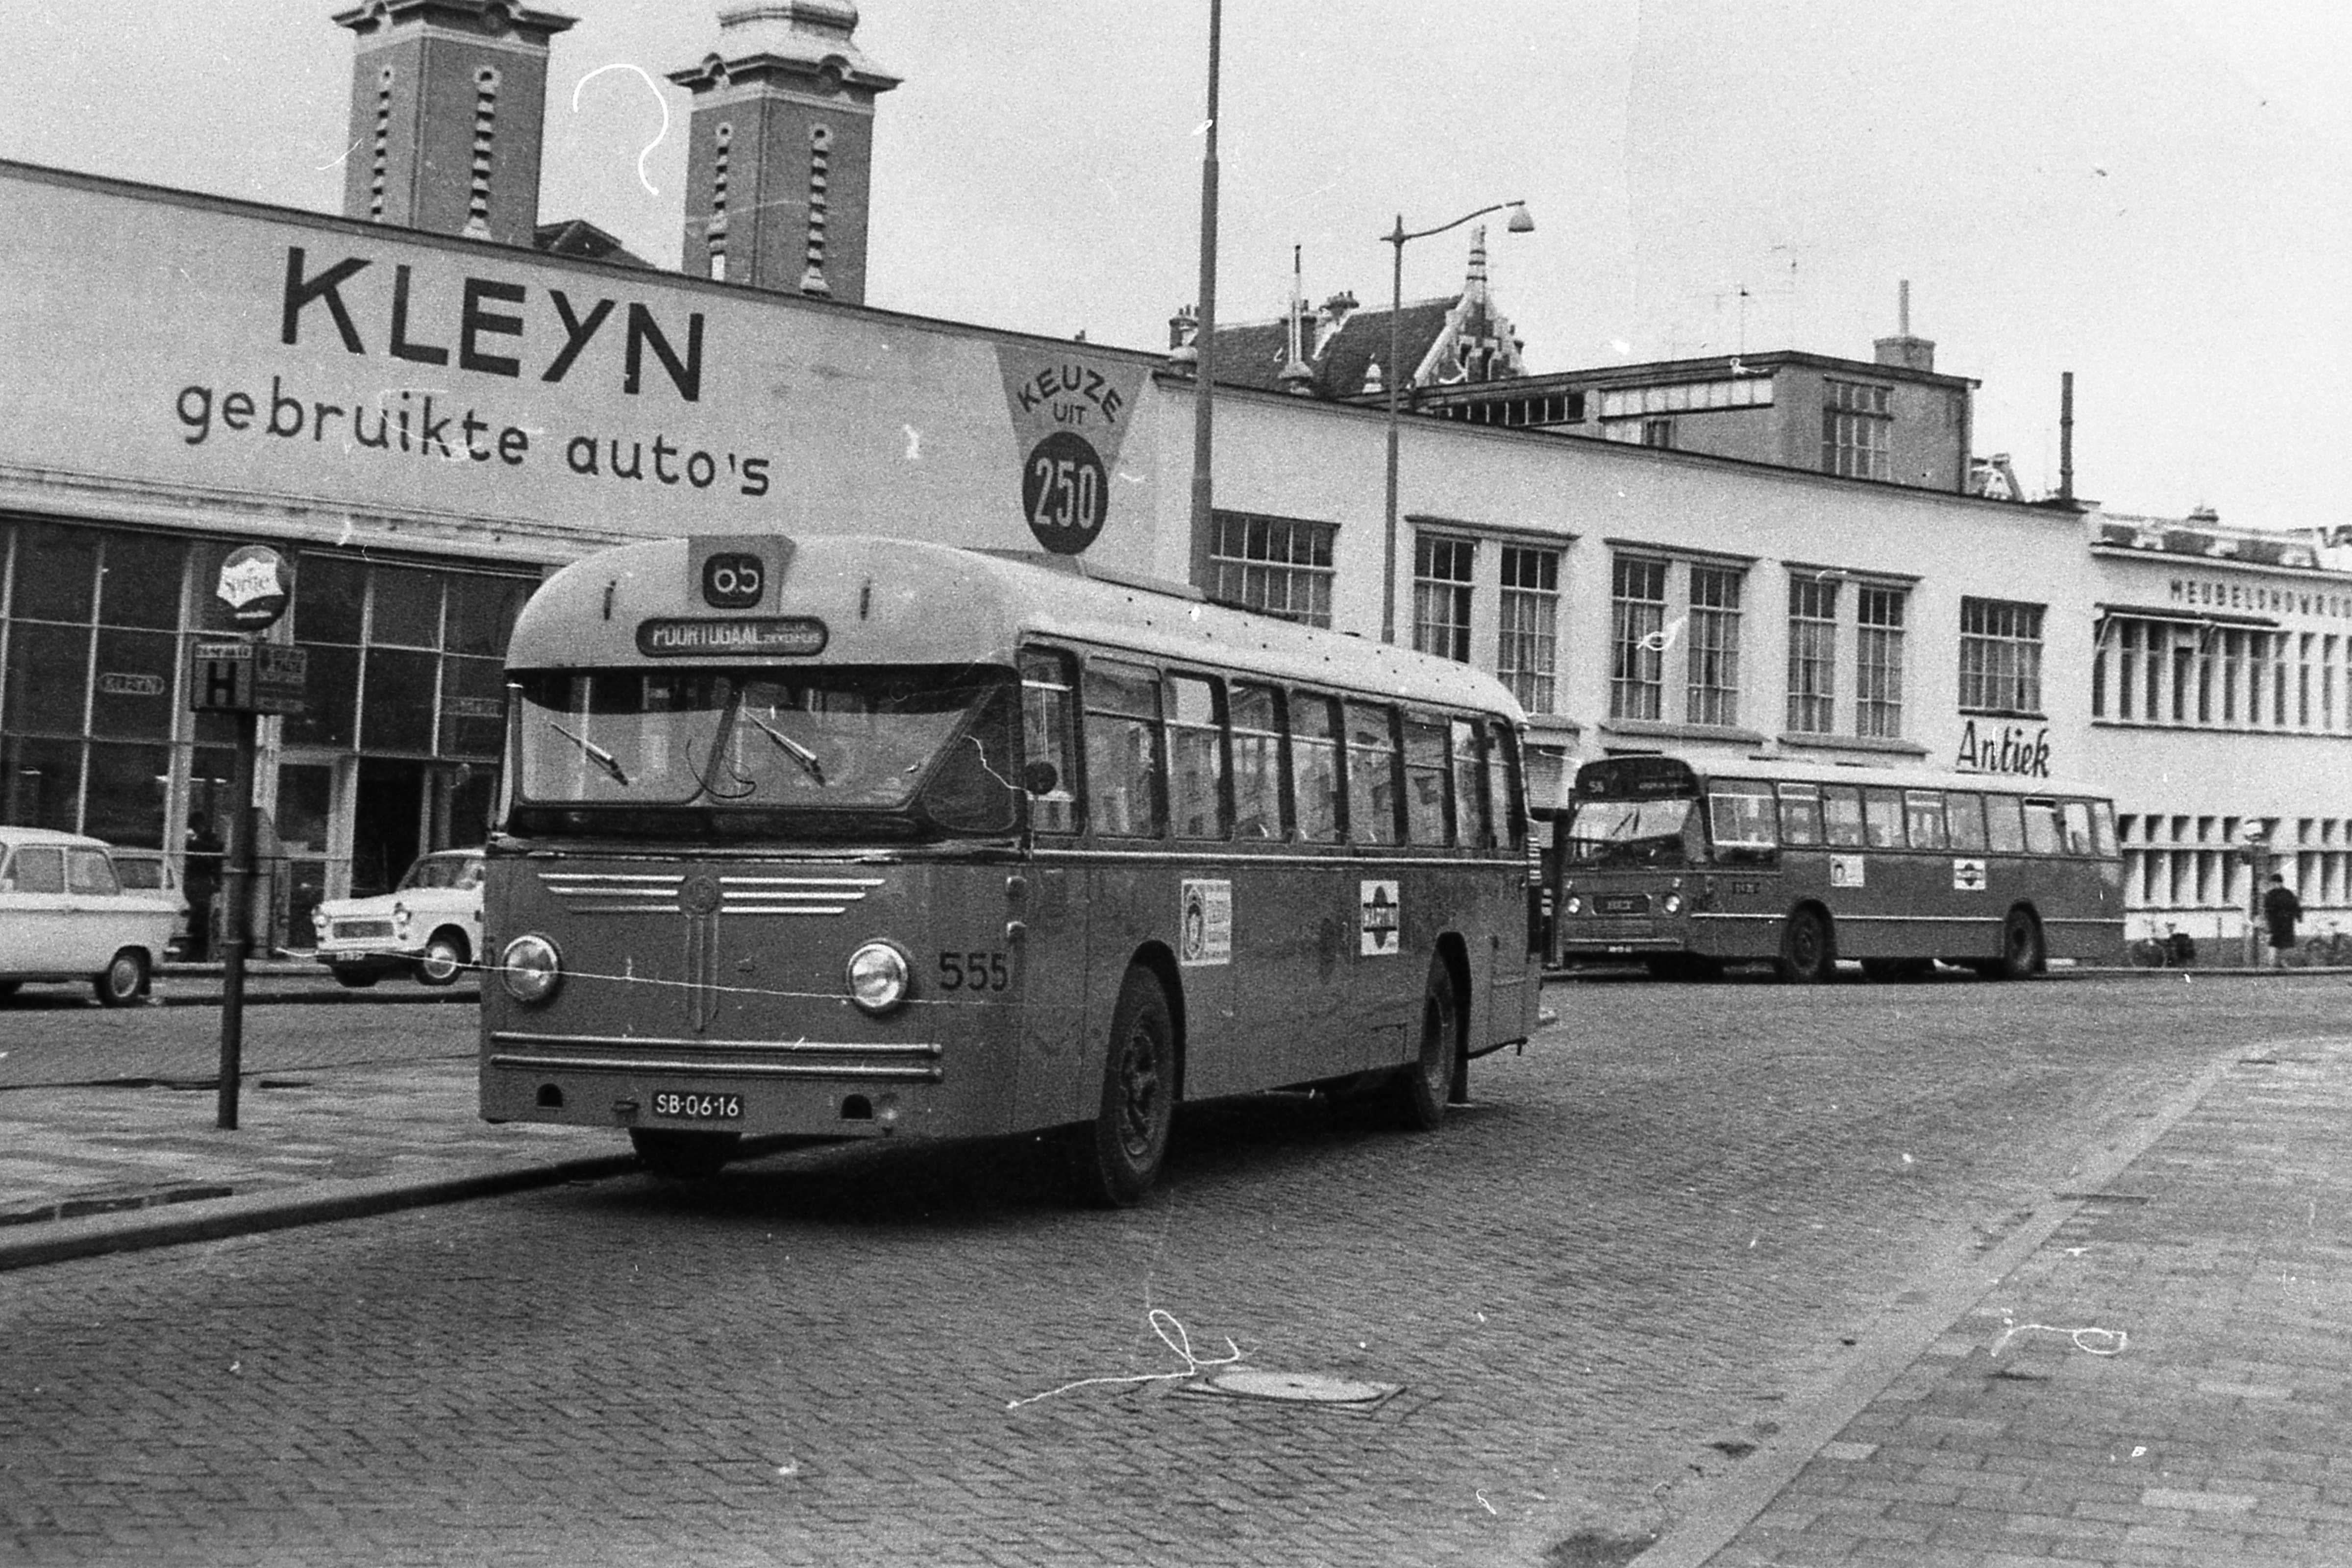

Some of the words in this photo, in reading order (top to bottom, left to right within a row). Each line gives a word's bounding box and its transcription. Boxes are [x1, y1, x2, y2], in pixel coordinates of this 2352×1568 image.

[282, 246, 704, 403] KLEYN
[1017, 364, 1123, 423] KEUZE
[1053, 402, 1086, 424] UIT
[176, 375, 528, 466] gebruikte
[567, 434, 770, 497] auto's
[1033, 457, 1098, 529] 250
[206, 661, 238, 705] H
[1956, 720, 2050, 778] Antiek
[939, 952, 1008, 991] 555
